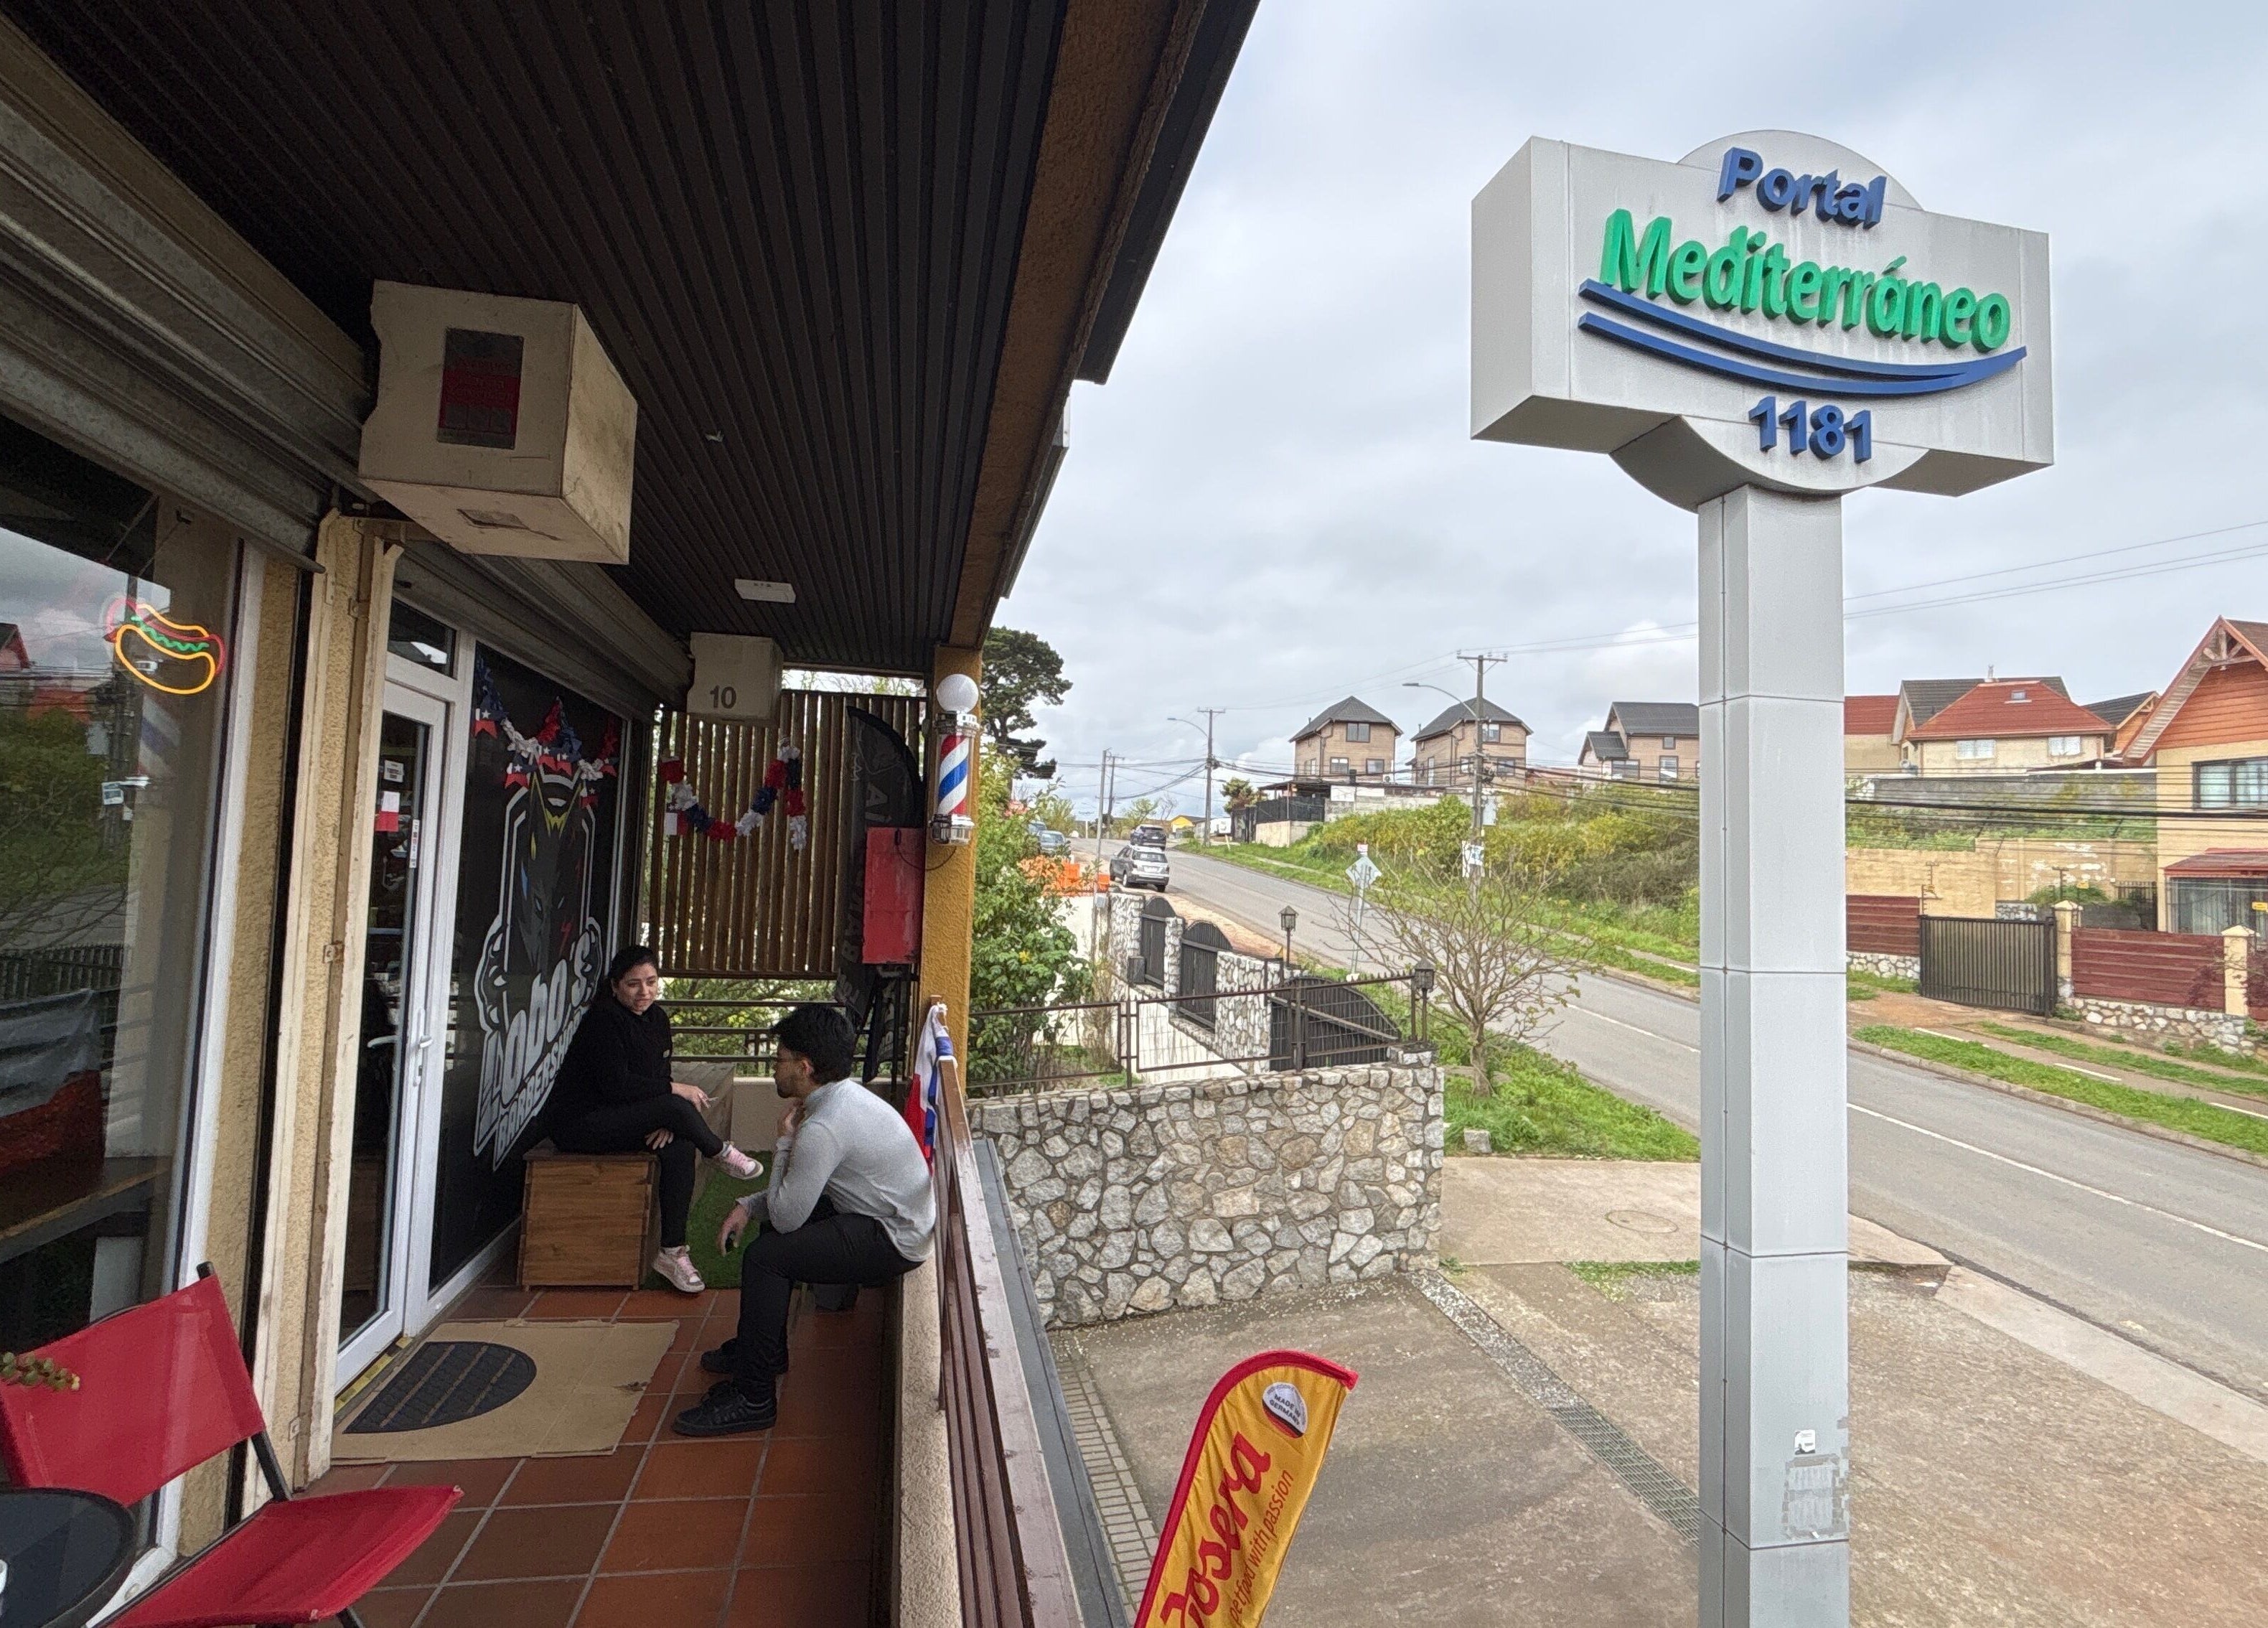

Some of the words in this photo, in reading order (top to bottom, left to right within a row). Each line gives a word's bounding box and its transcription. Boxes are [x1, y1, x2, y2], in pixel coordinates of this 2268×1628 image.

[1717, 147, 1886, 229] Portal
[1599, 208, 2011, 352] Mediterráneo
[1748, 396, 1872, 463] 1181
[710, 685, 736, 708] 10
[1274, 1394, 1294, 1410] MADE
[1248, 1528, 1270, 1568] with
[1262, 1469, 1295, 1538] passion
